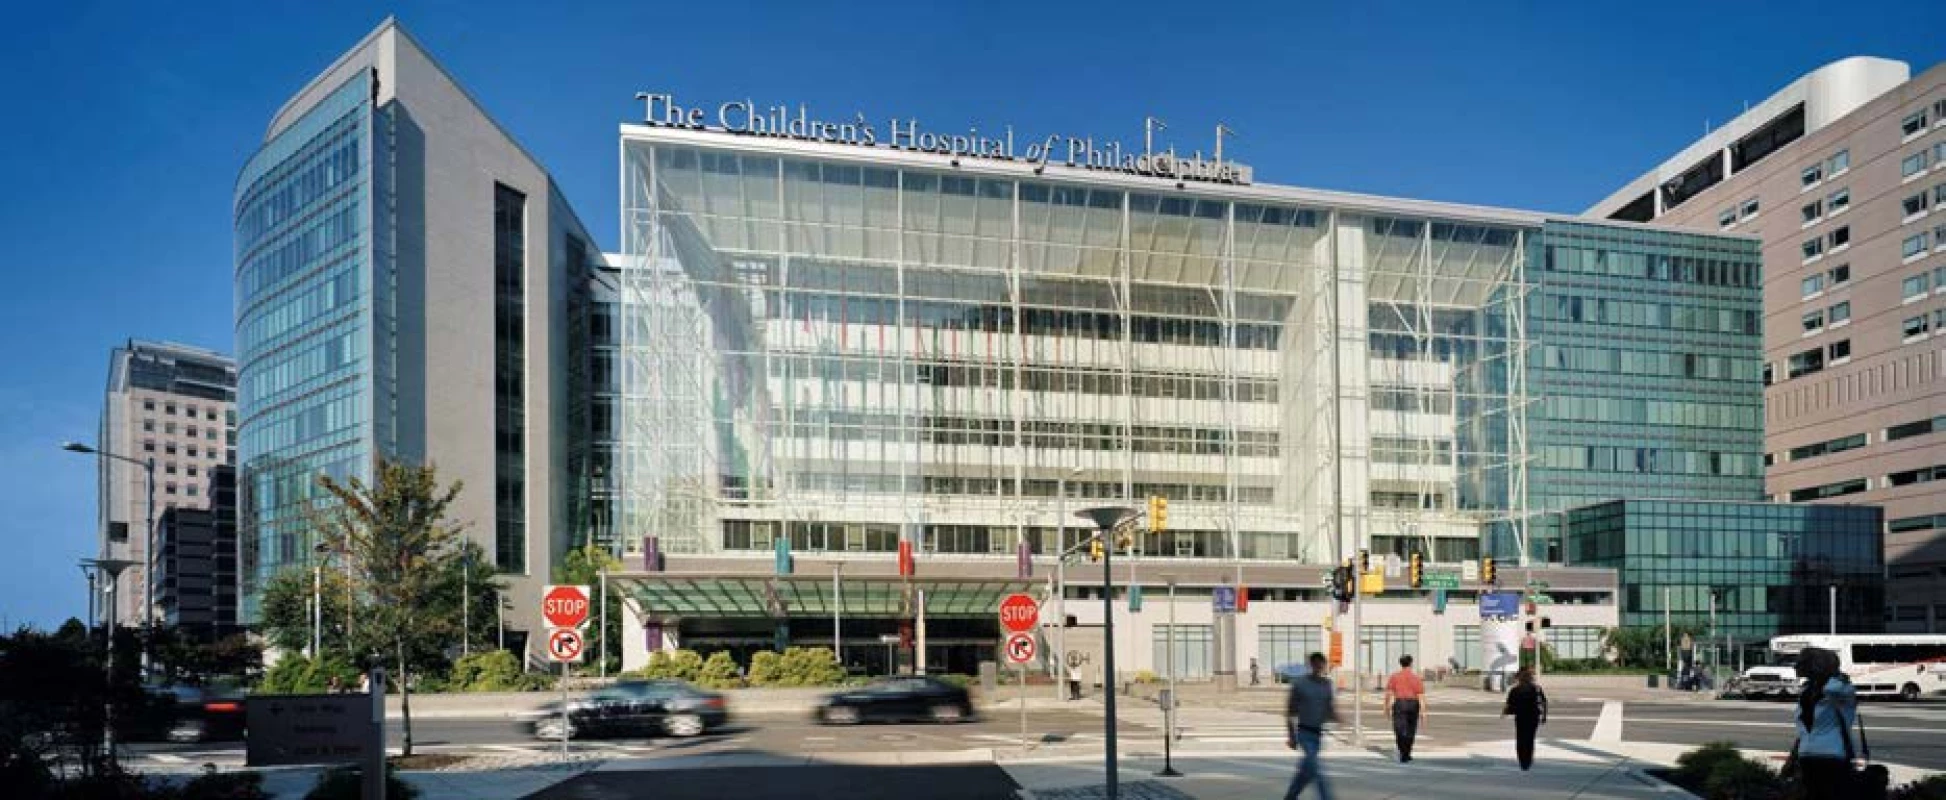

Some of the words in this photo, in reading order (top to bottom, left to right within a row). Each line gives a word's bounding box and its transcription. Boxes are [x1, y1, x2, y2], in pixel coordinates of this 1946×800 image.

[634, 91, 705, 130] The
[718, 98, 876, 146] Children's
[889, 115, 1014, 166] Hospital
[1026, 134, 1061, 175] of
[1066, 136, 1235, 189] Philadelphia
[547, 599, 584, 616] STOP
[1003, 605, 1036, 622] STOP
